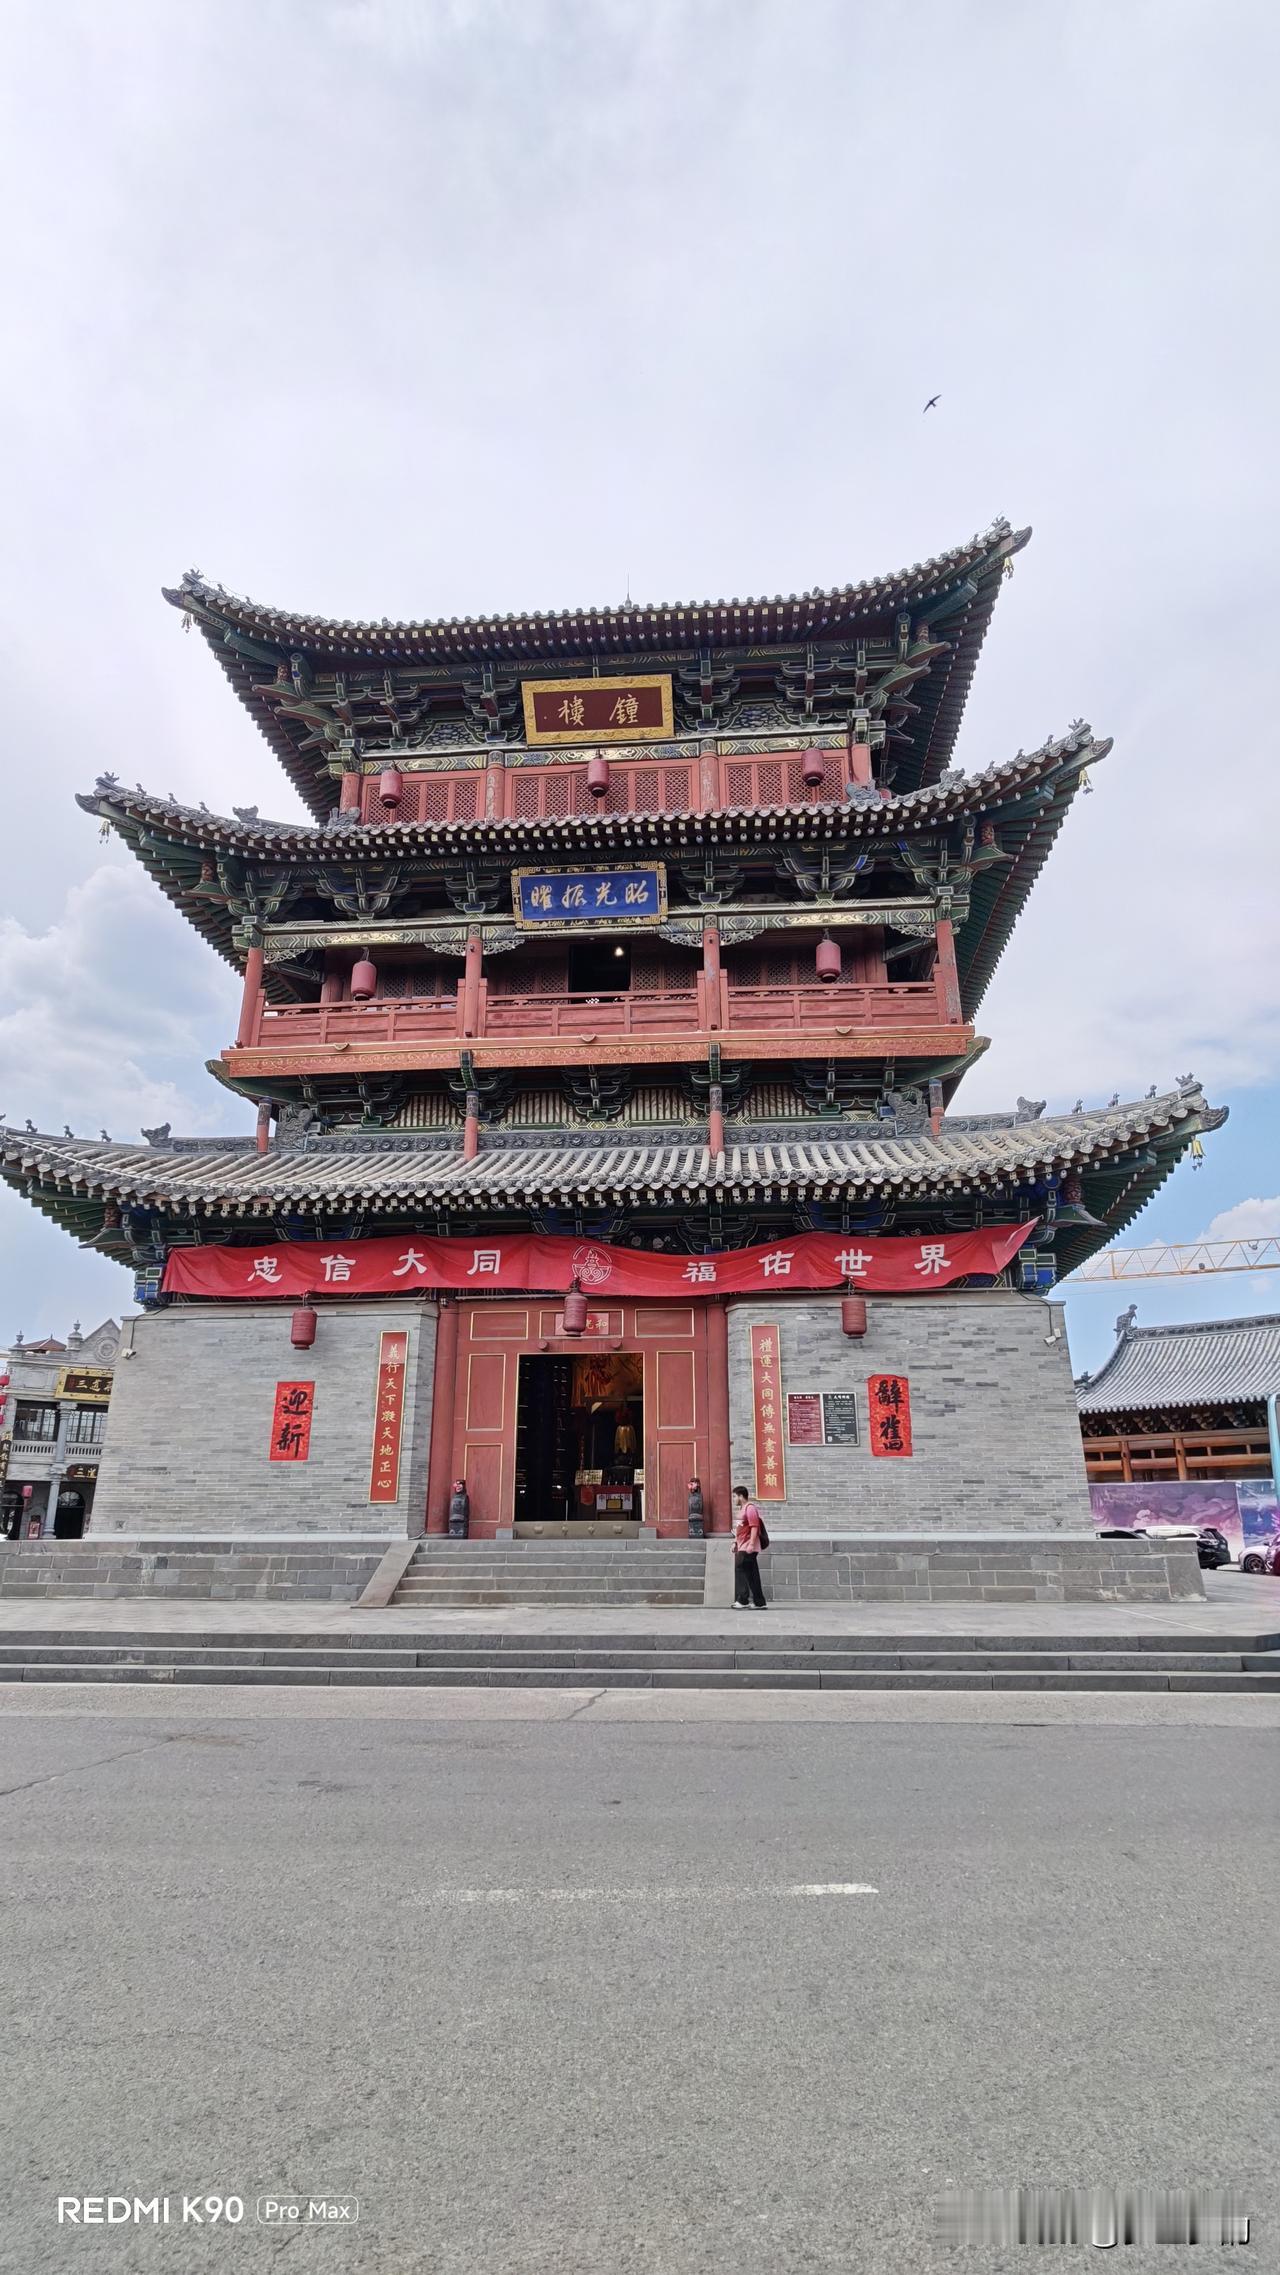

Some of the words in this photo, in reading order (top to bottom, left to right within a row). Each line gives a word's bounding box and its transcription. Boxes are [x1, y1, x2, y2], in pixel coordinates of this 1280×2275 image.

[247, 1247, 502, 1284] 忠信大同
[681, 1244, 951, 1283] 福佑世界
[276, 1388, 309, 1459] 迎新
